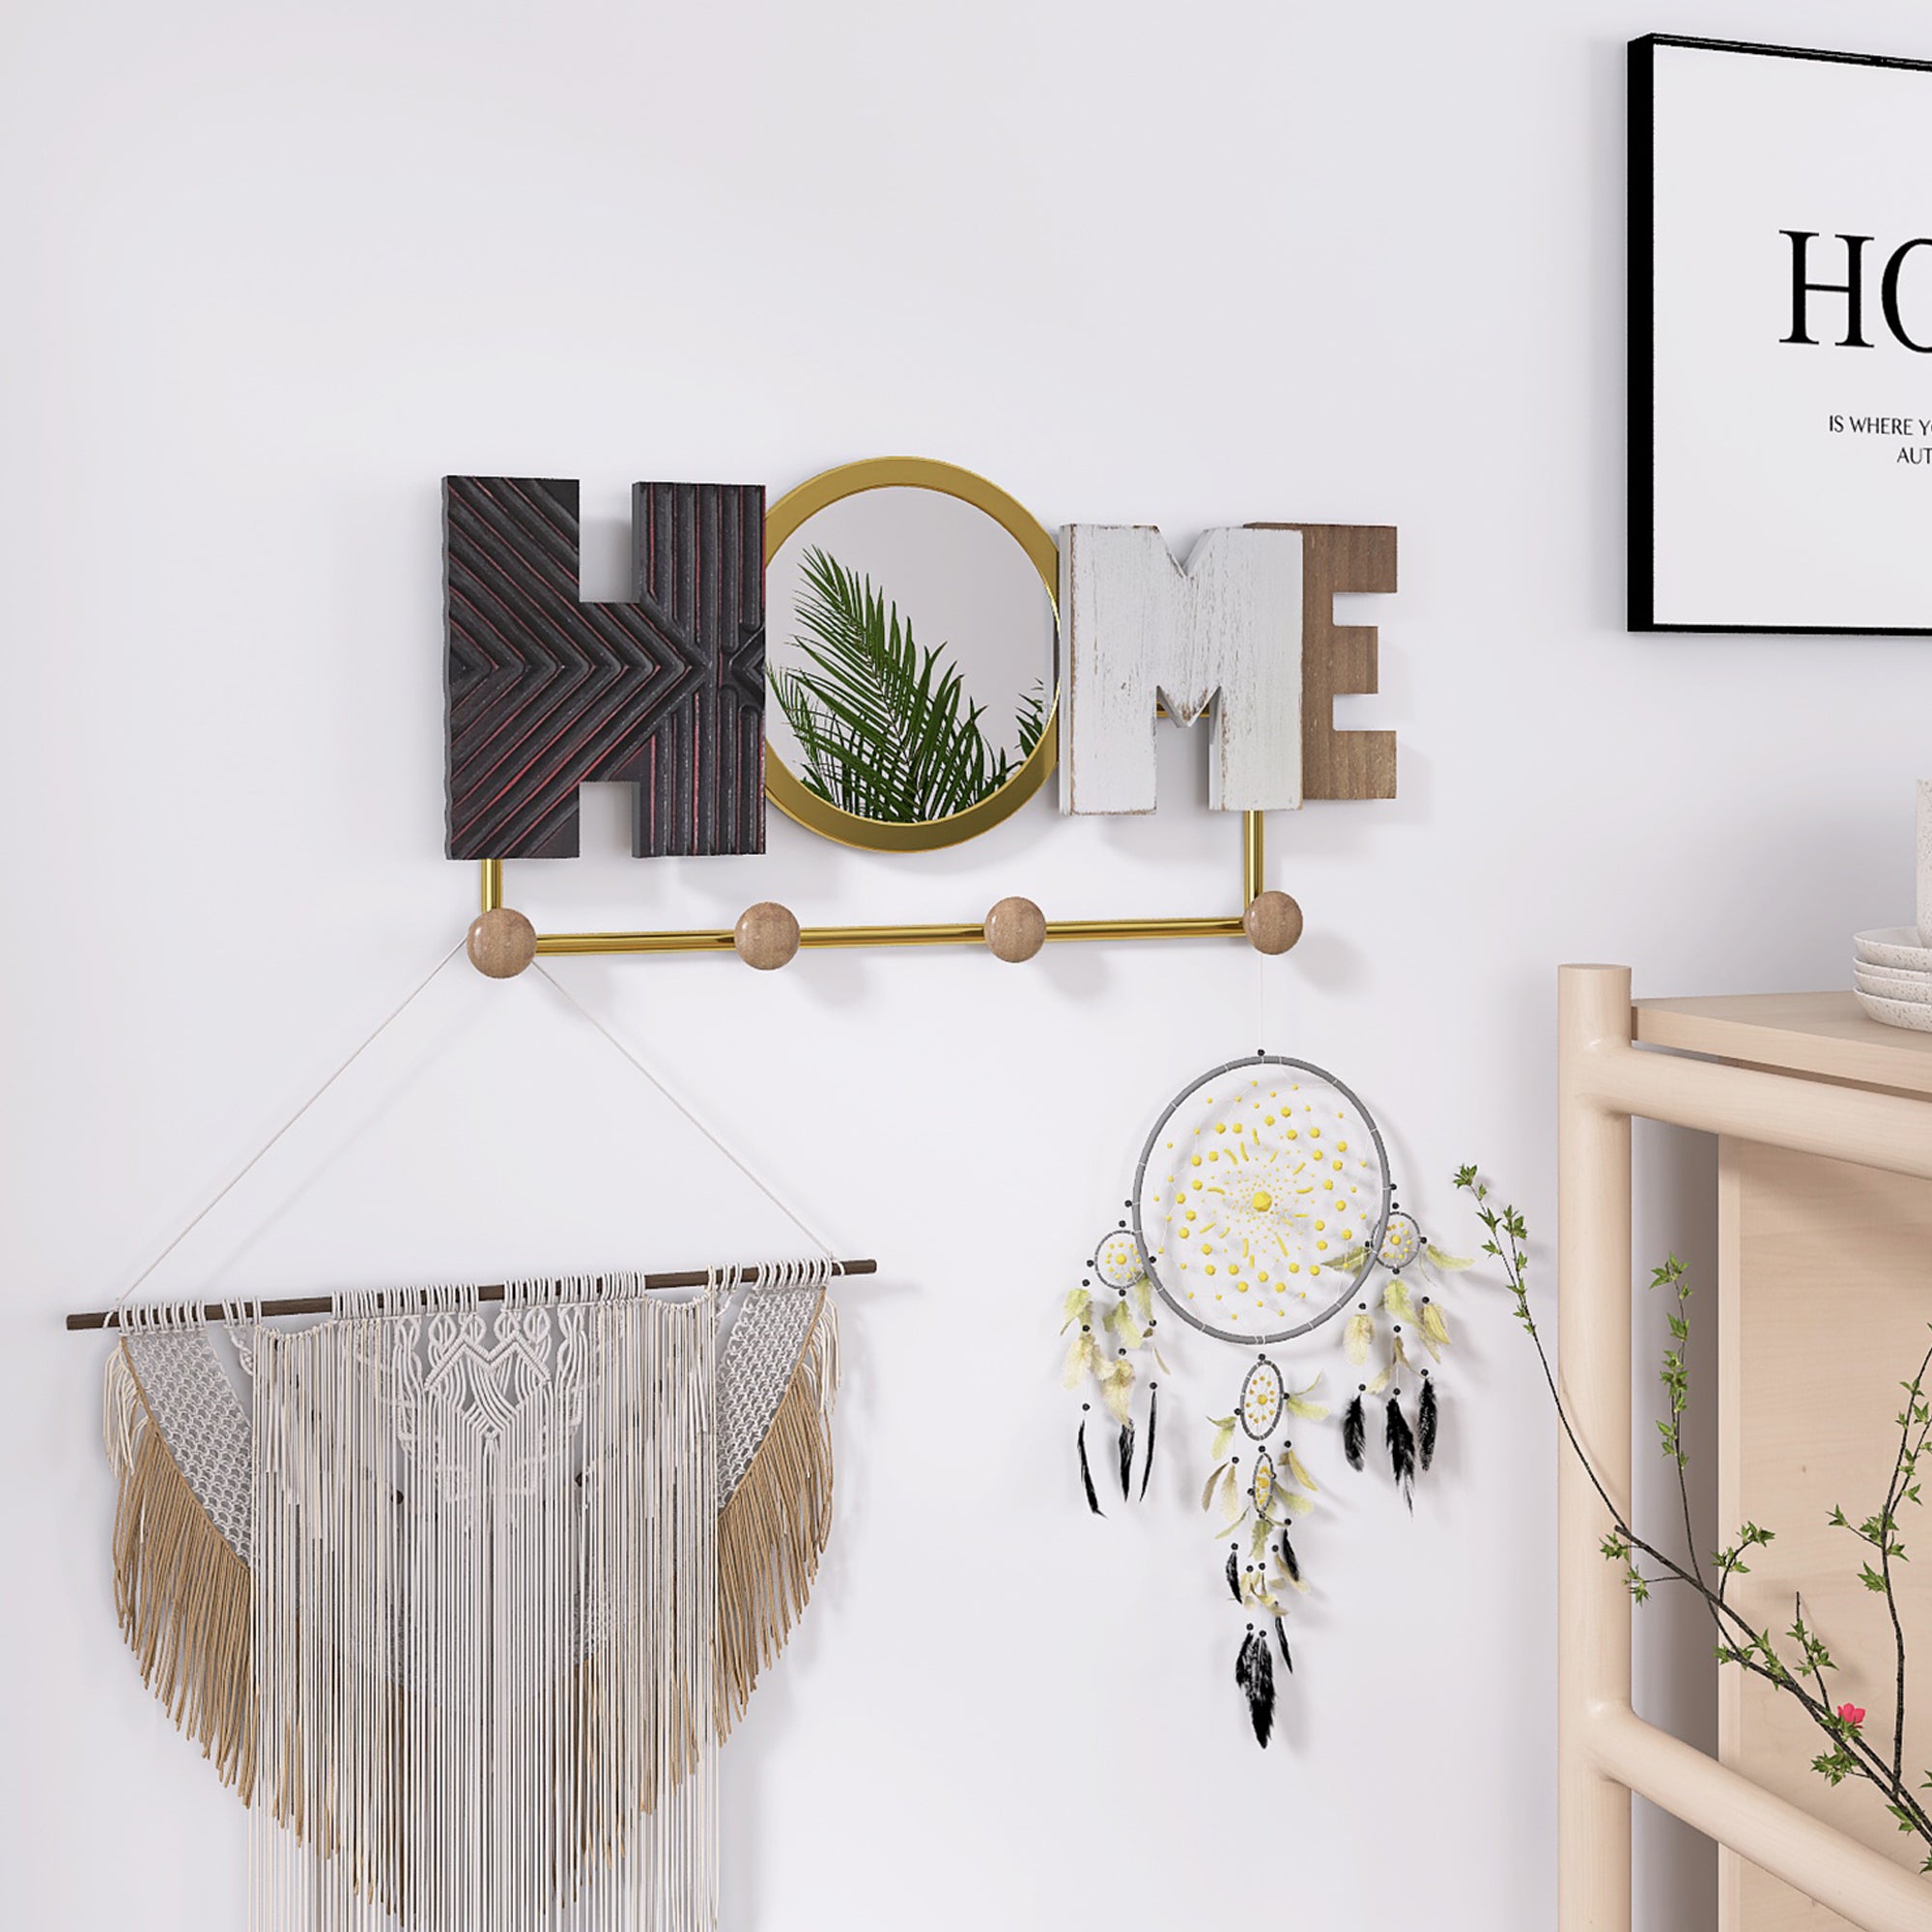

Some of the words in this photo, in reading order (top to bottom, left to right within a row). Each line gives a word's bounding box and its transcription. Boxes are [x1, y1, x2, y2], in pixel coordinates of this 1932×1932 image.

[1829, 414, 1844, 434] IS
[1849, 415, 1914, 436] WHERE
[1918, 418, 1932, 437] Y
[442, 456, 1398, 860] HOME
